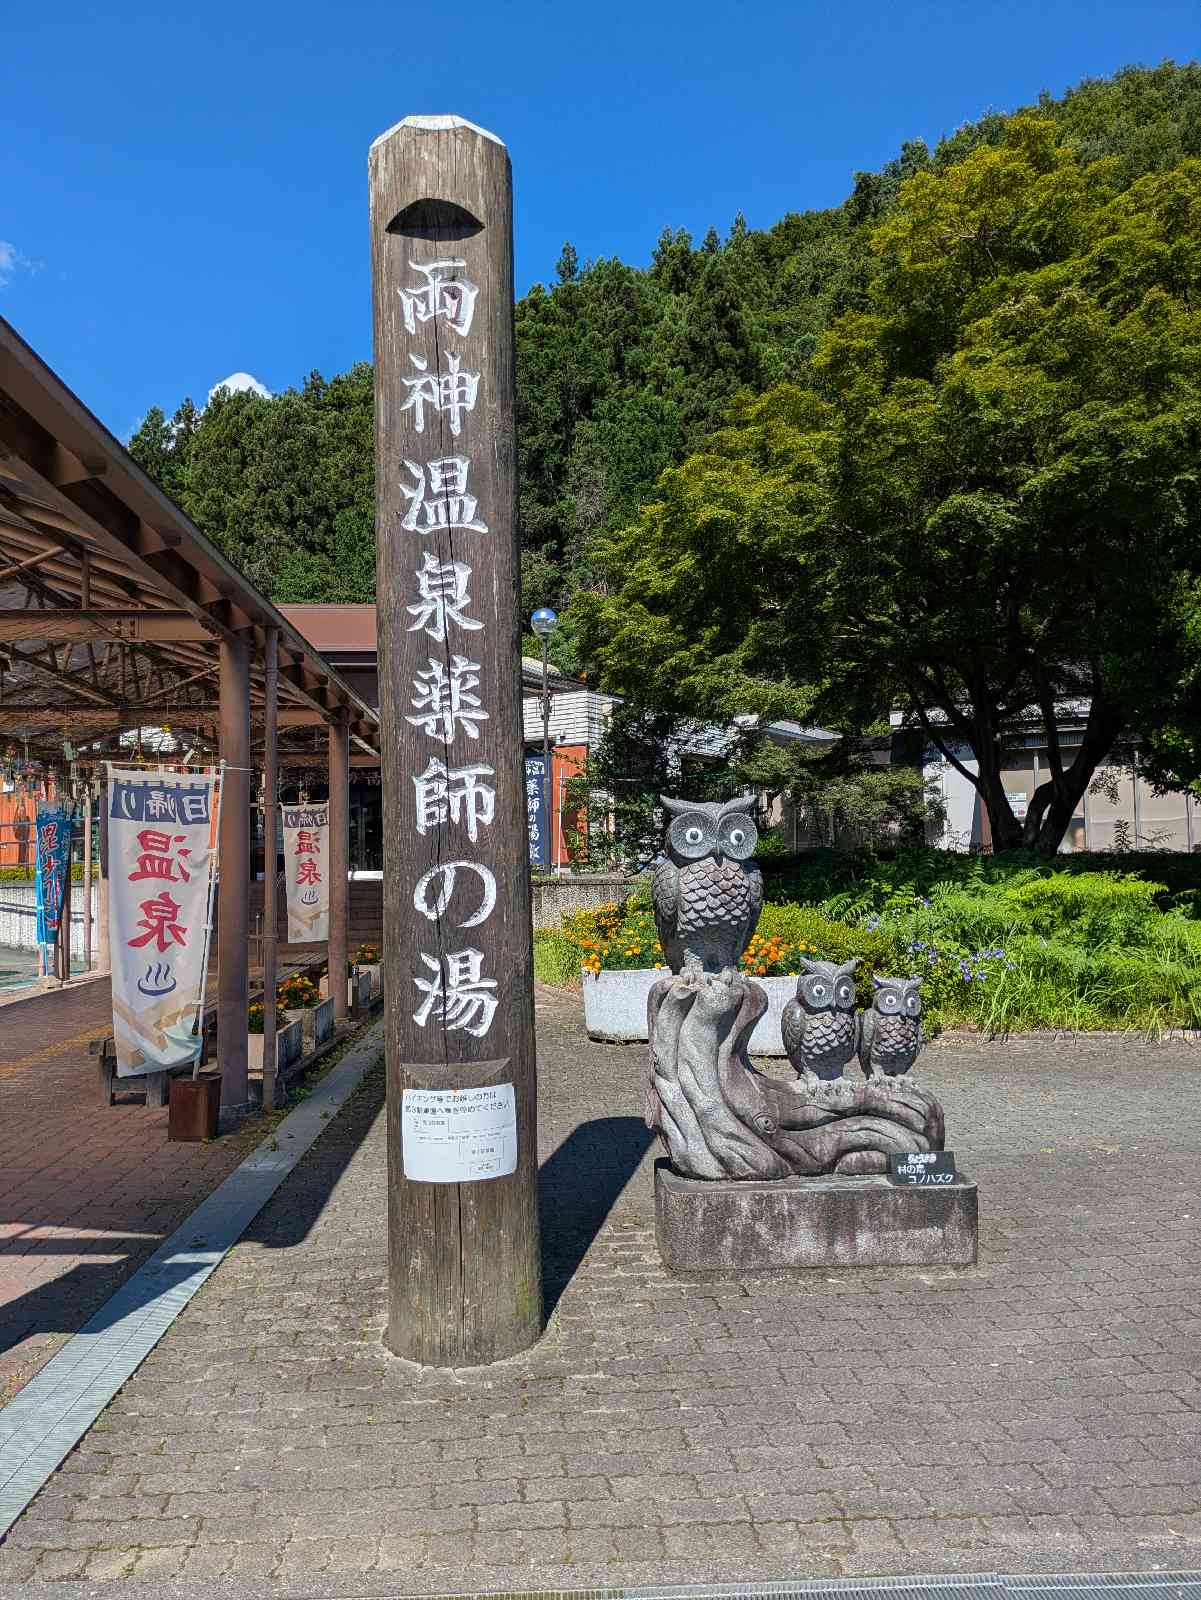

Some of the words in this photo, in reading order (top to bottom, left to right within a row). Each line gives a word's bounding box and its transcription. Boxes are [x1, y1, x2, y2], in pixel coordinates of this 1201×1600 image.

[397, 256, 500, 1038] 両神温泉薬師の湯
[908, 1173, 953, 1185] コノハズク
